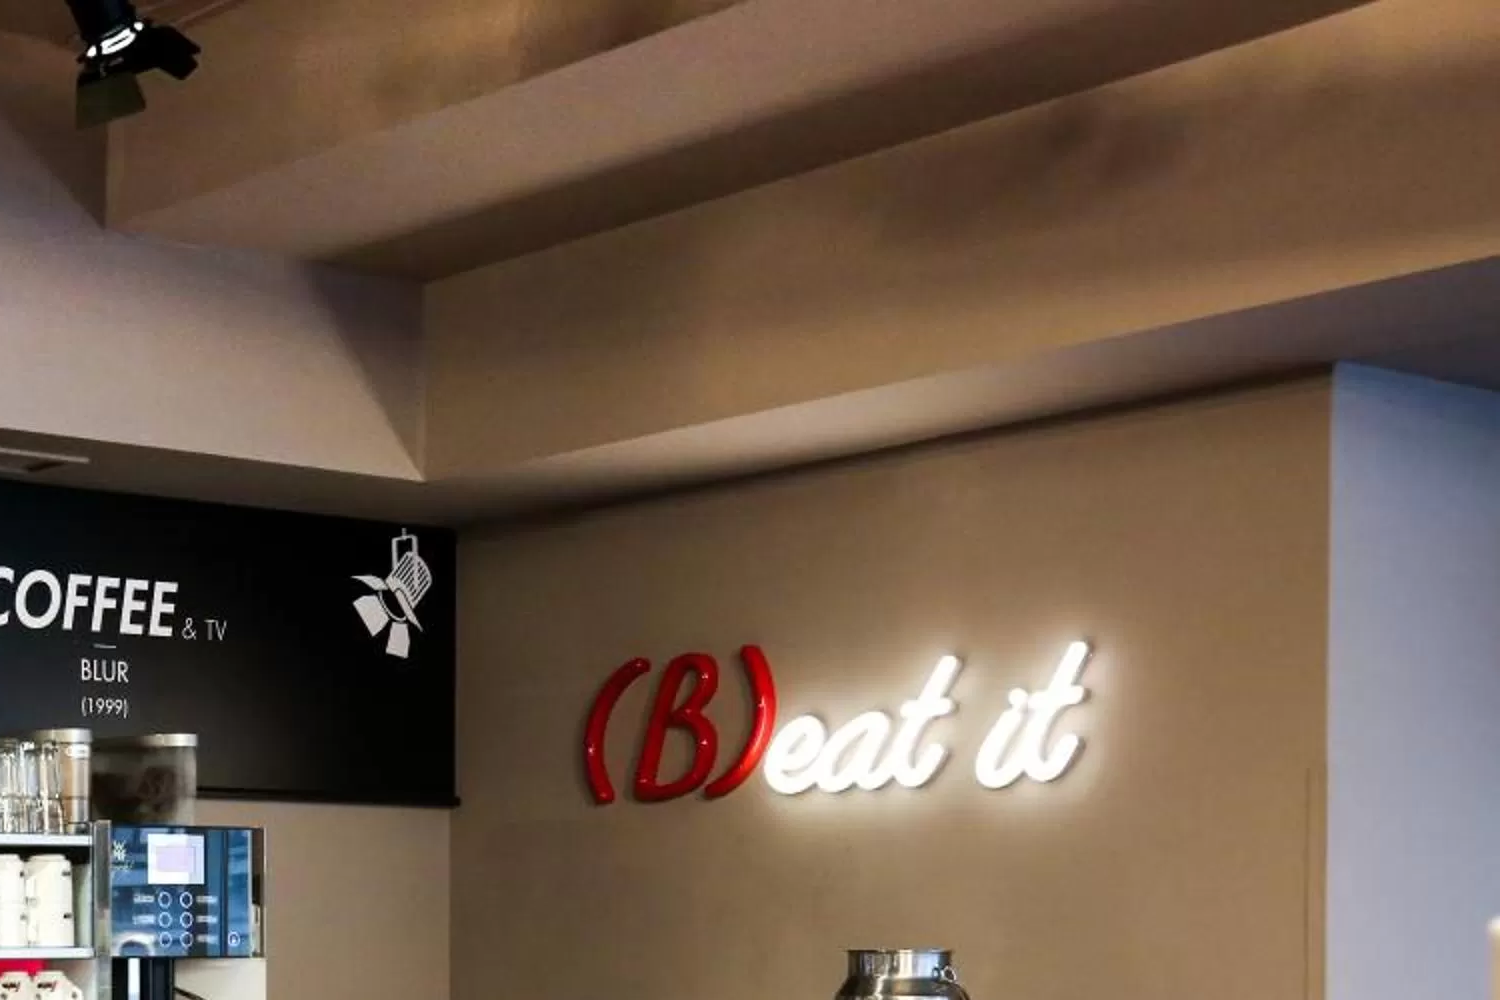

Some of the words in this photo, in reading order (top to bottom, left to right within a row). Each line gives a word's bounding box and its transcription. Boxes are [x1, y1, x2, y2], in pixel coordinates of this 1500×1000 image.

[181, 617, 198, 640] &
[204, 618, 228, 641] TV
[80, 659, 129, 684] BLUR
[80, 697, 129, 719] (1999)
[975, 640, 1088, 790] it
